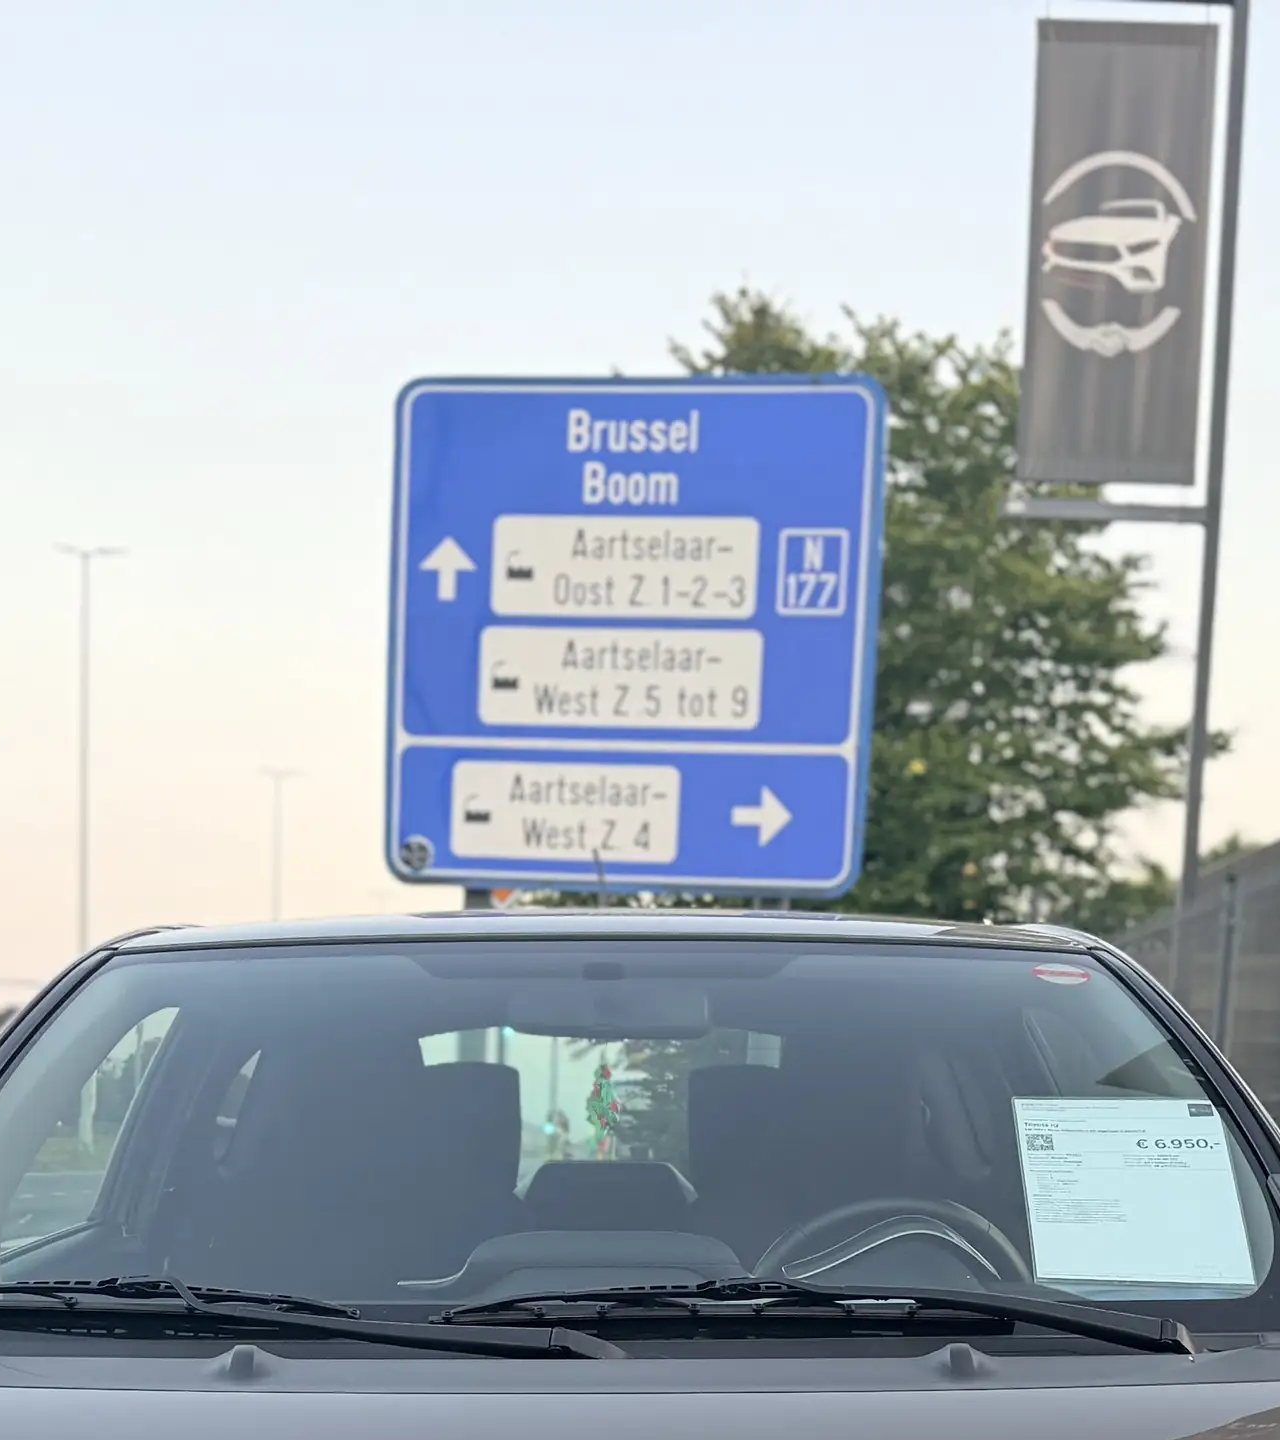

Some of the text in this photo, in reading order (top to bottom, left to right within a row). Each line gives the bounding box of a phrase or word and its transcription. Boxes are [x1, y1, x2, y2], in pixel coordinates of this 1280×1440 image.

[566, 408, 700, 453] Brussel
[582, 461, 680, 505] Boom
[571, 528, 734, 562] Aartselaar-
[802, 536, 824, 572] N
[553, 572, 747, 609] Oost Z 1-2-3
[786, 572, 839, 608] 177
[561, 638, 723, 672] Aartselaar-
[534, 684, 749, 719] West Z 5 tot 9
[508, 773, 668, 808] Aartselaar-
[522, 816, 651, 852] West Z 4
[1136, 1138, 1221, 1150] € 6.950,-
